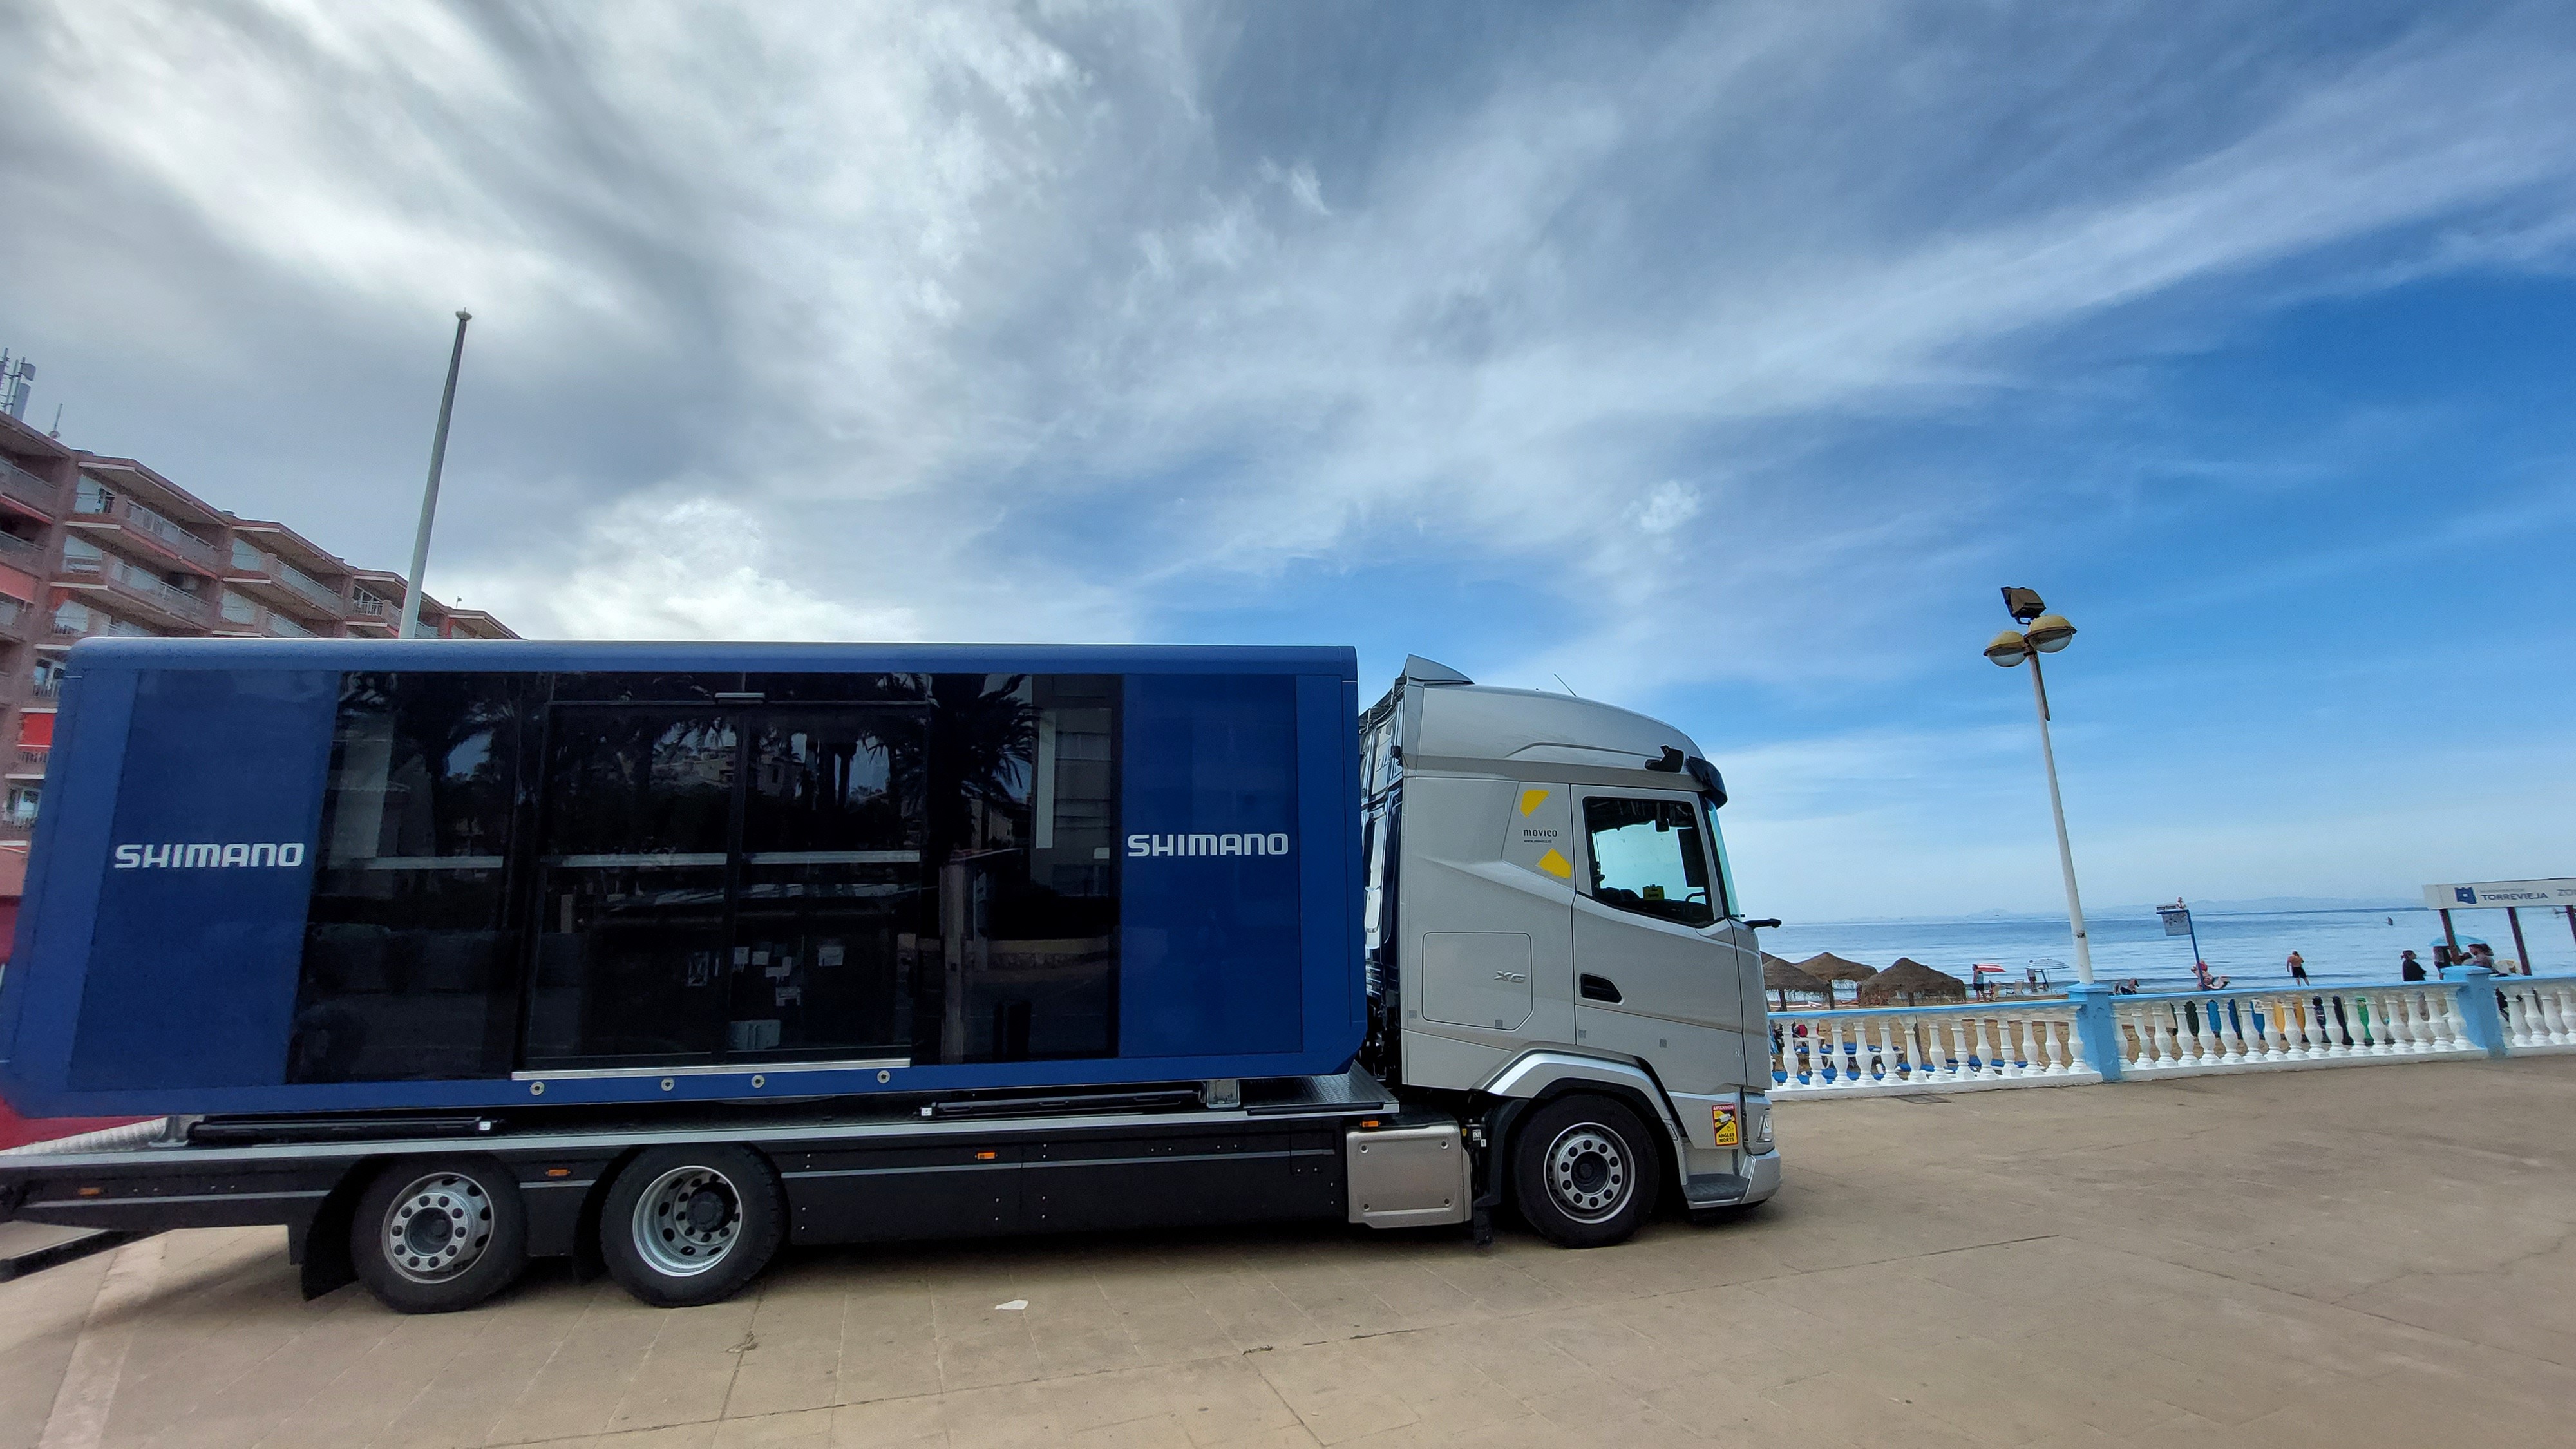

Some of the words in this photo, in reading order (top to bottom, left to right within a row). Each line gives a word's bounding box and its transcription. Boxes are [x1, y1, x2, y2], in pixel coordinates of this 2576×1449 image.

[114, 842, 305, 868] SHIMANO
[1128, 833, 1289, 857] SHIMANO
[1493, 971, 1526, 983] XG
